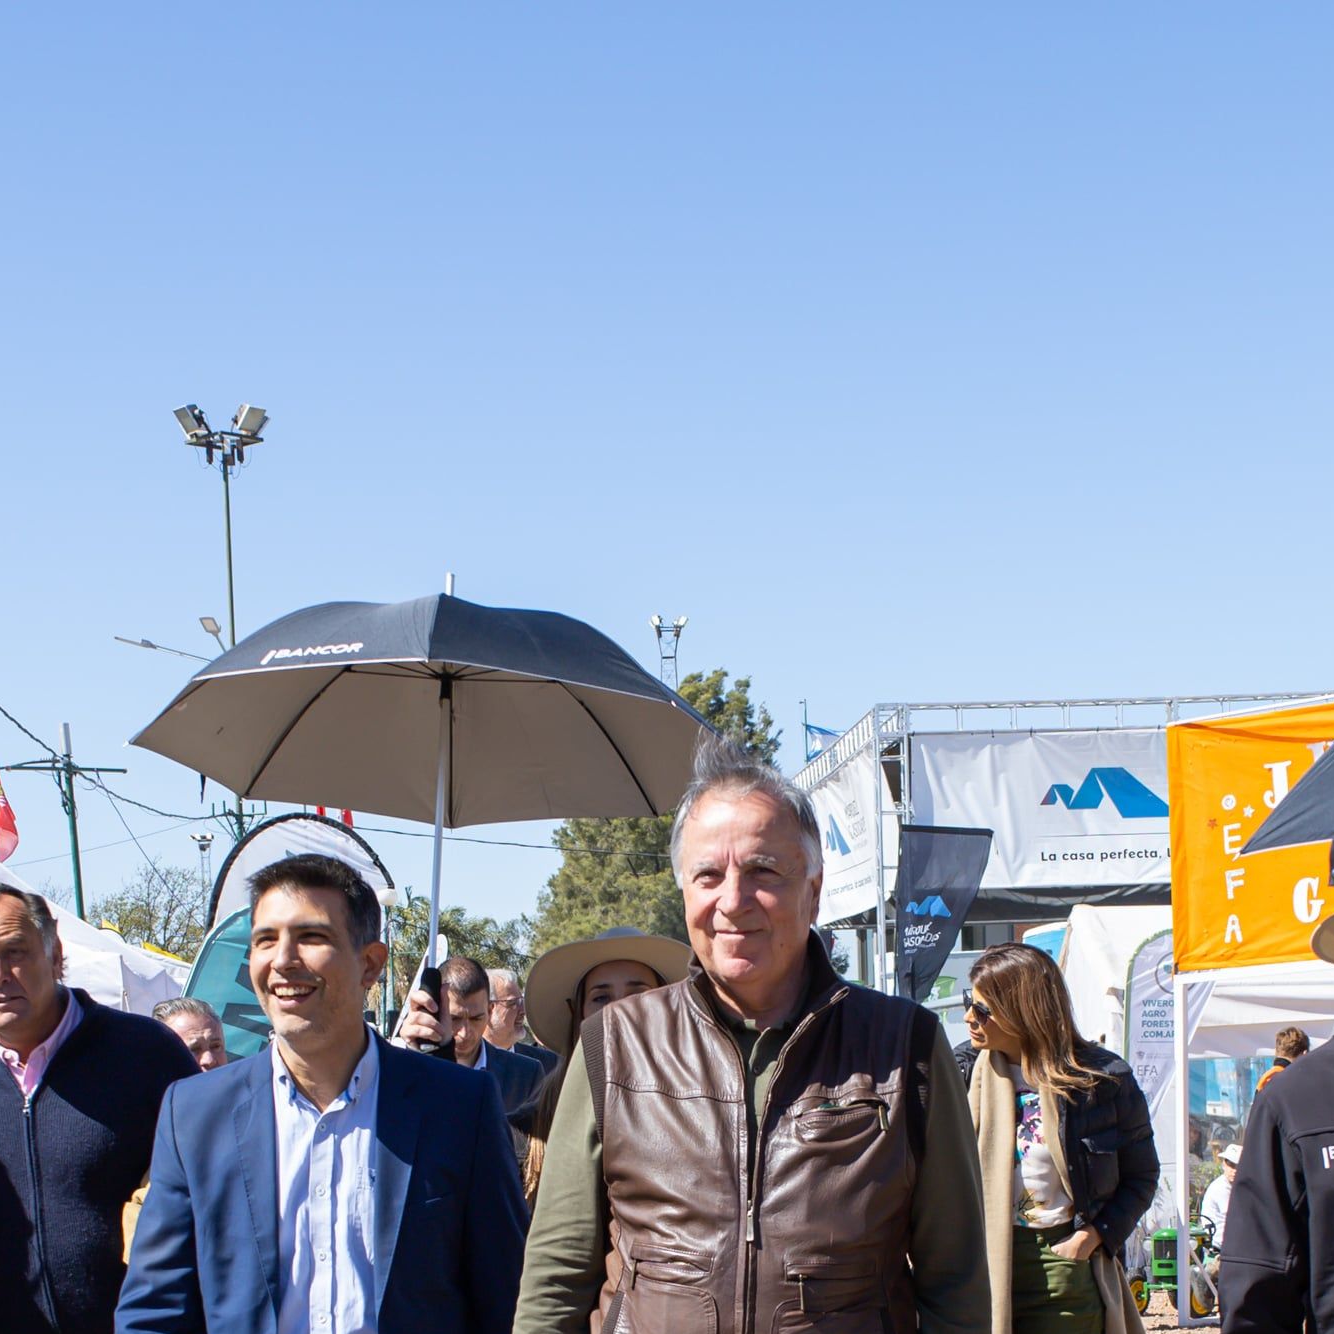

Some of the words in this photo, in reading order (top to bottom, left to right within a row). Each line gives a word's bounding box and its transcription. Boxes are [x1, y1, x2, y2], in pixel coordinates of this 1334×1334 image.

[273, 642, 364, 659] BANCOR
[1041, 851, 1057, 861] La
[1062, 852, 1095, 861] casa
[1100, 848, 1162, 862] perfecta,
[1141, 1009, 1167, 1018] AGRO
[1141, 1019, 1175, 1028] FOREST
[1137, 1065, 1158, 1076] EFA
